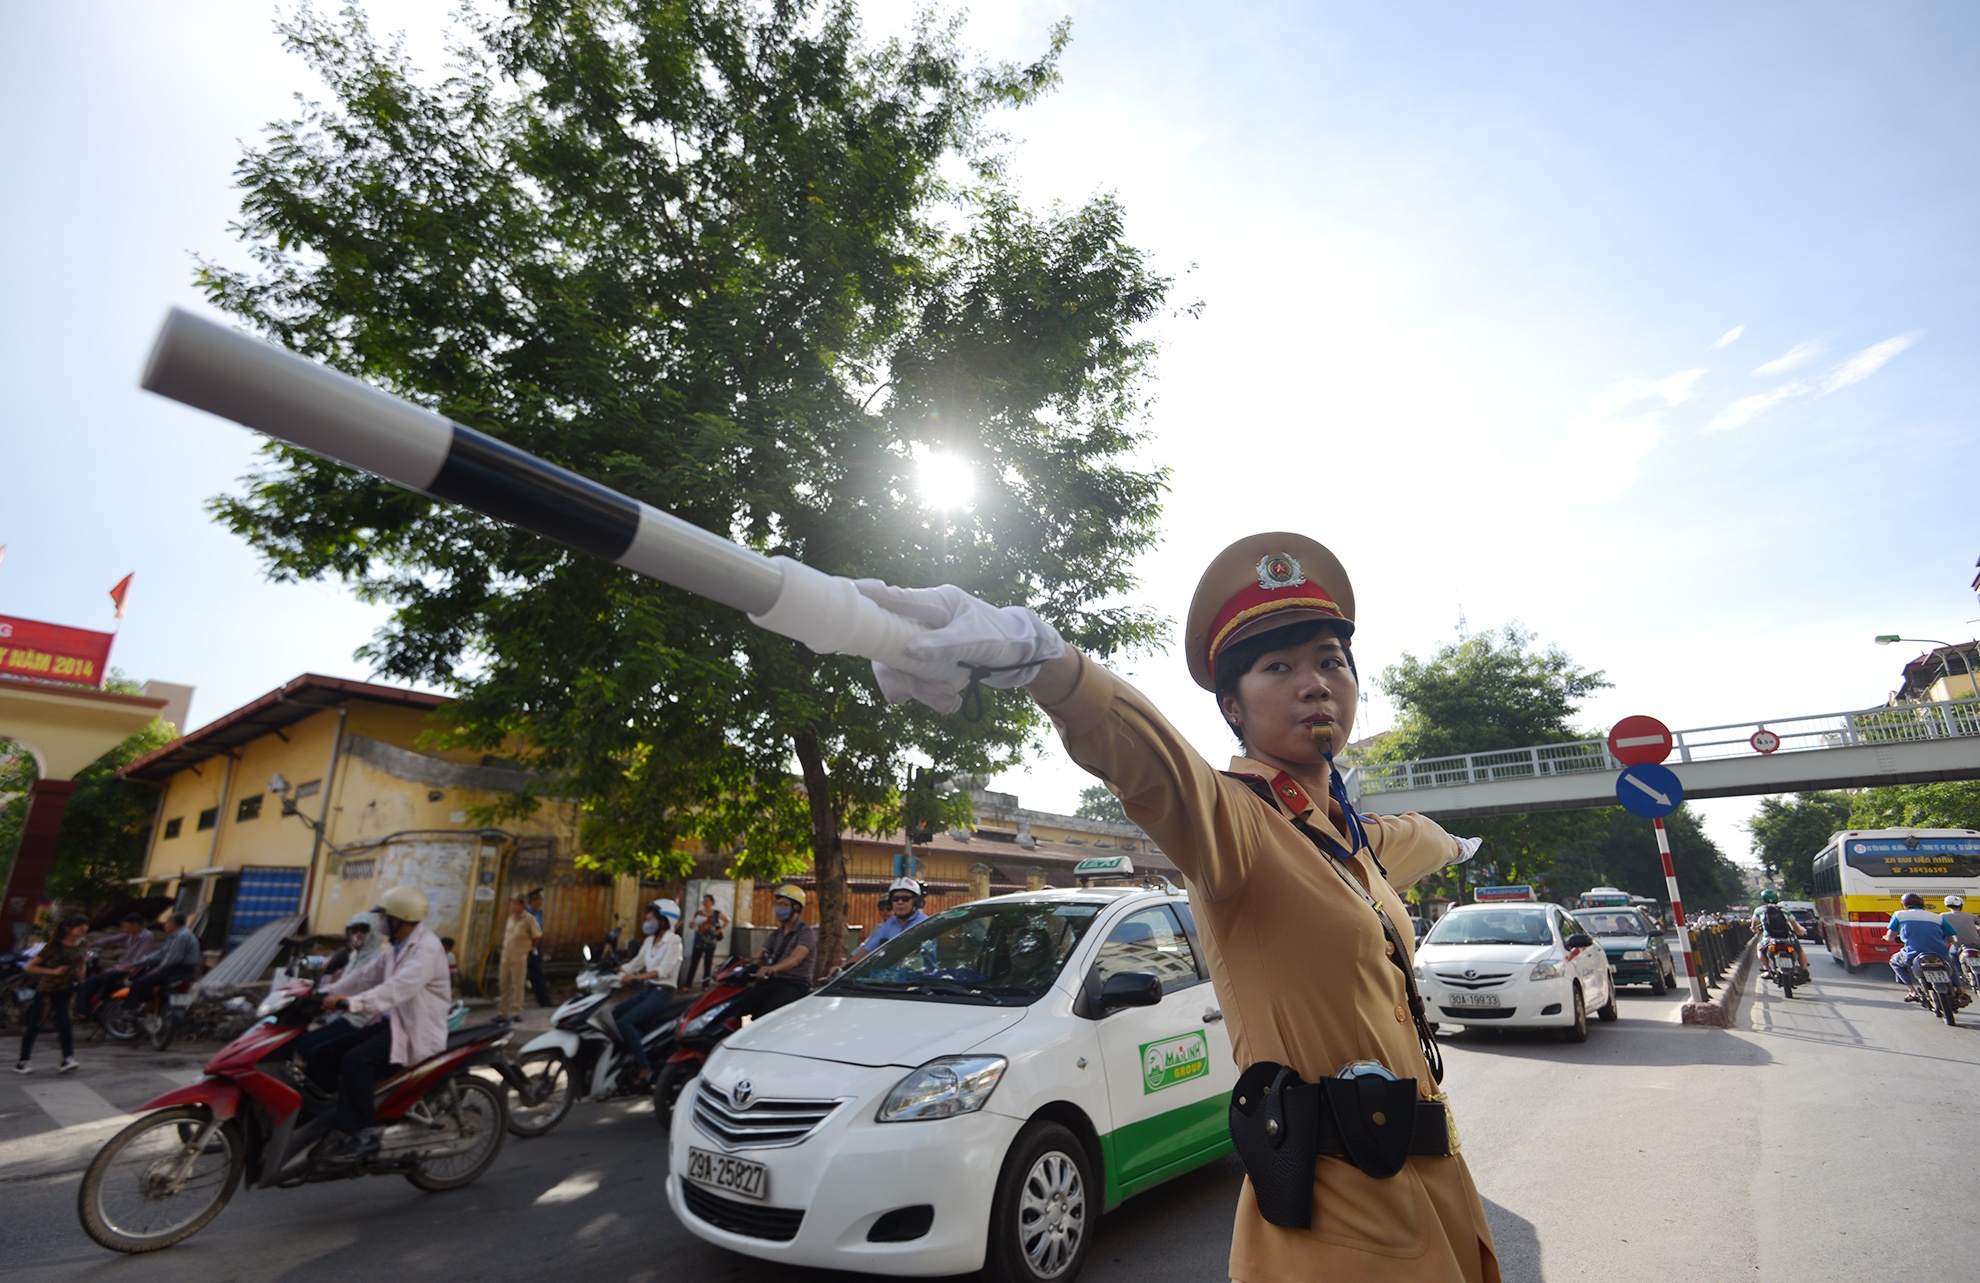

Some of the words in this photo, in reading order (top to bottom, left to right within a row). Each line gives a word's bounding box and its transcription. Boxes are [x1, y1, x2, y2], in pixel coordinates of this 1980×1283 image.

[8, 648, 53, 672] NĂM
[53, 656, 94, 678] 2014
[1081, 858, 1123, 870] TAXI
[1174, 1061, 1202, 1078] GROUP
